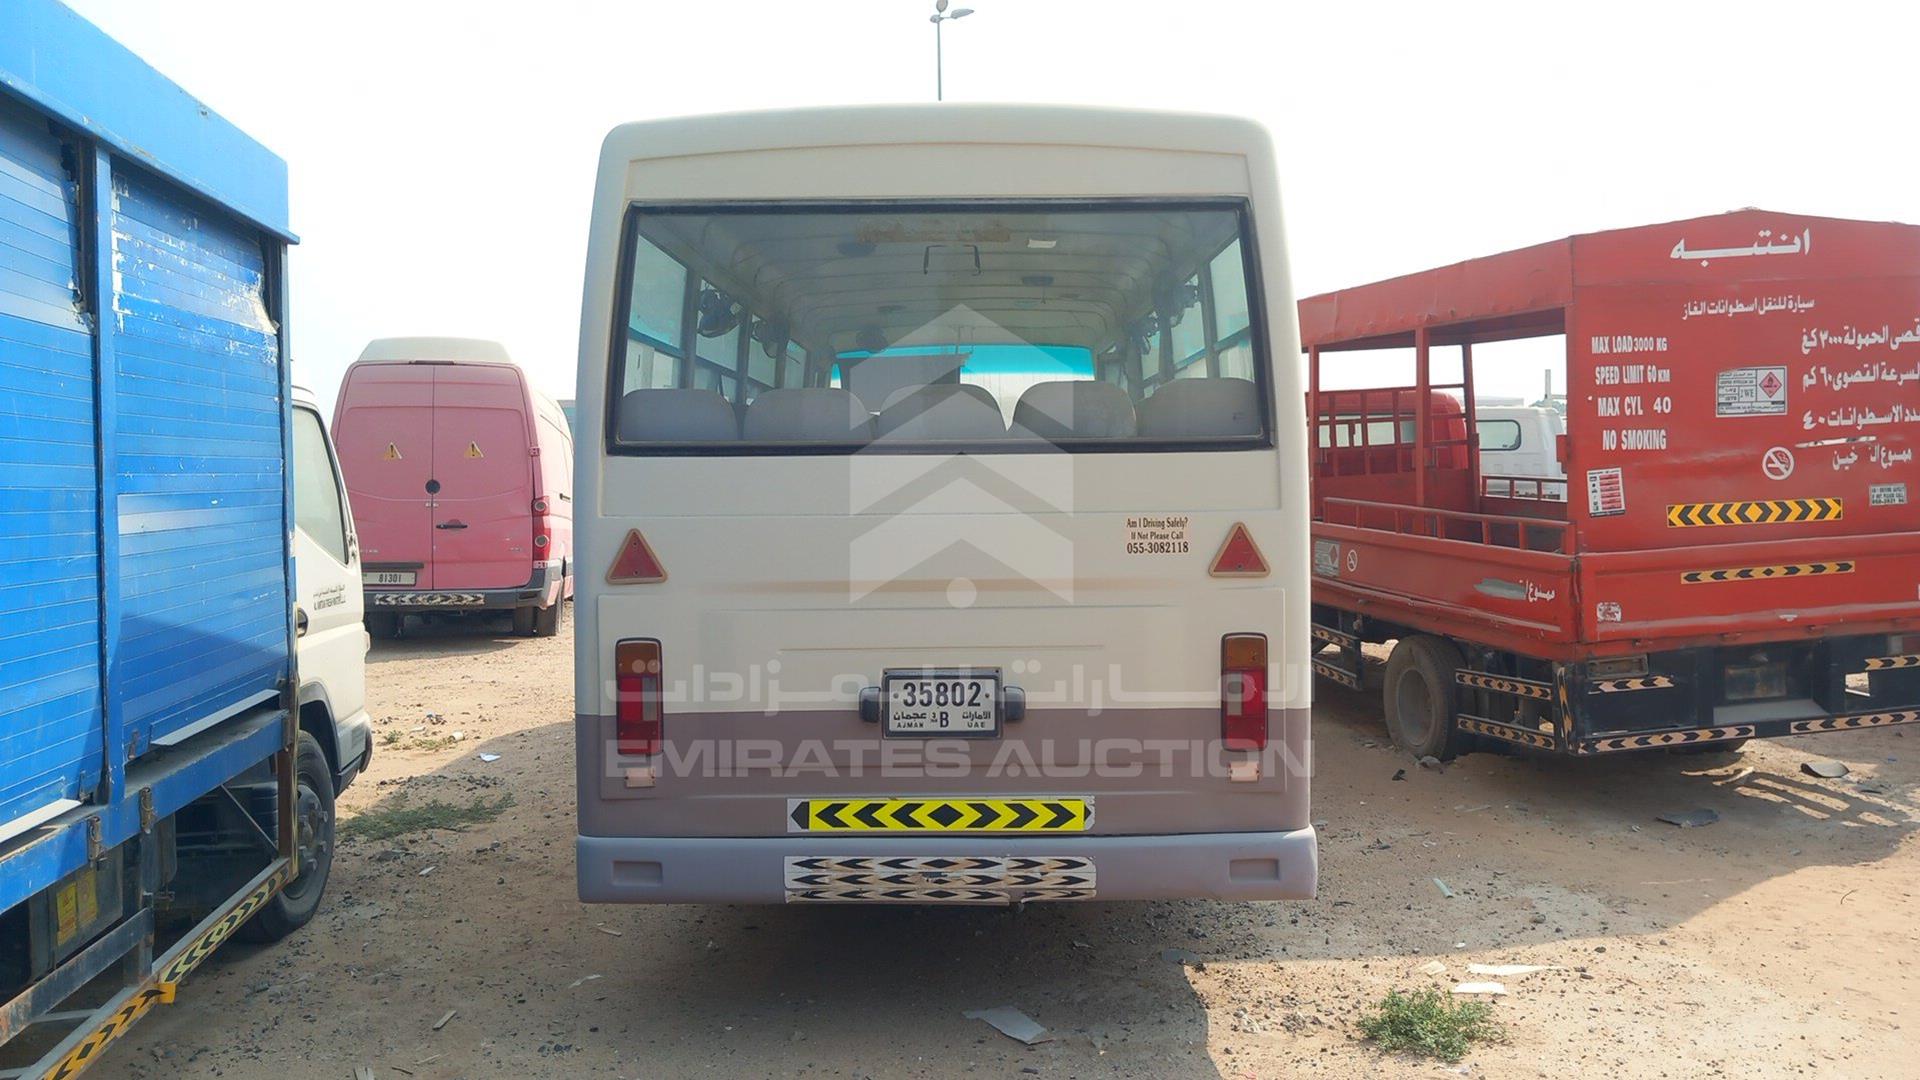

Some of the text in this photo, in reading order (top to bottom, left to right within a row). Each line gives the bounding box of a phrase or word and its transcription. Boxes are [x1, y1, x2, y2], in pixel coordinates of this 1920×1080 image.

[1670, 228, 1810, 267] انتبه
[1682, 301, 1706, 320] الغاز
[1707, 297, 1758, 317] اسطوانات
[1788, 294, 1815, 312] سيارة
[1591, 335, 1668, 354] MAX LOAD 3000 KG
[1843, 324, 1889, 350] الحمولة
[1595, 365, 1671, 385] SPEED LIMIT 60 KM
[1802, 365, 1817, 392] كم
[1597, 396, 1672, 417] MAX CYL 40
[1602, 429, 1667, 450] NO SMOKING
[1126, 518, 1137, 528] Am
[1142, 517, 1165, 530] Driving
[1166, 516, 1188, 529] Safely?
[1137, 531, 1149, 540] Not
[1150, 531, 1169, 540] Please
[1170, 531, 1184, 540] Call
[1126, 541, 1189, 554] 055-3082118
[378, 573, 402, 583] 81301
[903, 682, 981, 707] 35802
[893, 711, 927, 722] عجمان
[939, 711, 949, 728] B
